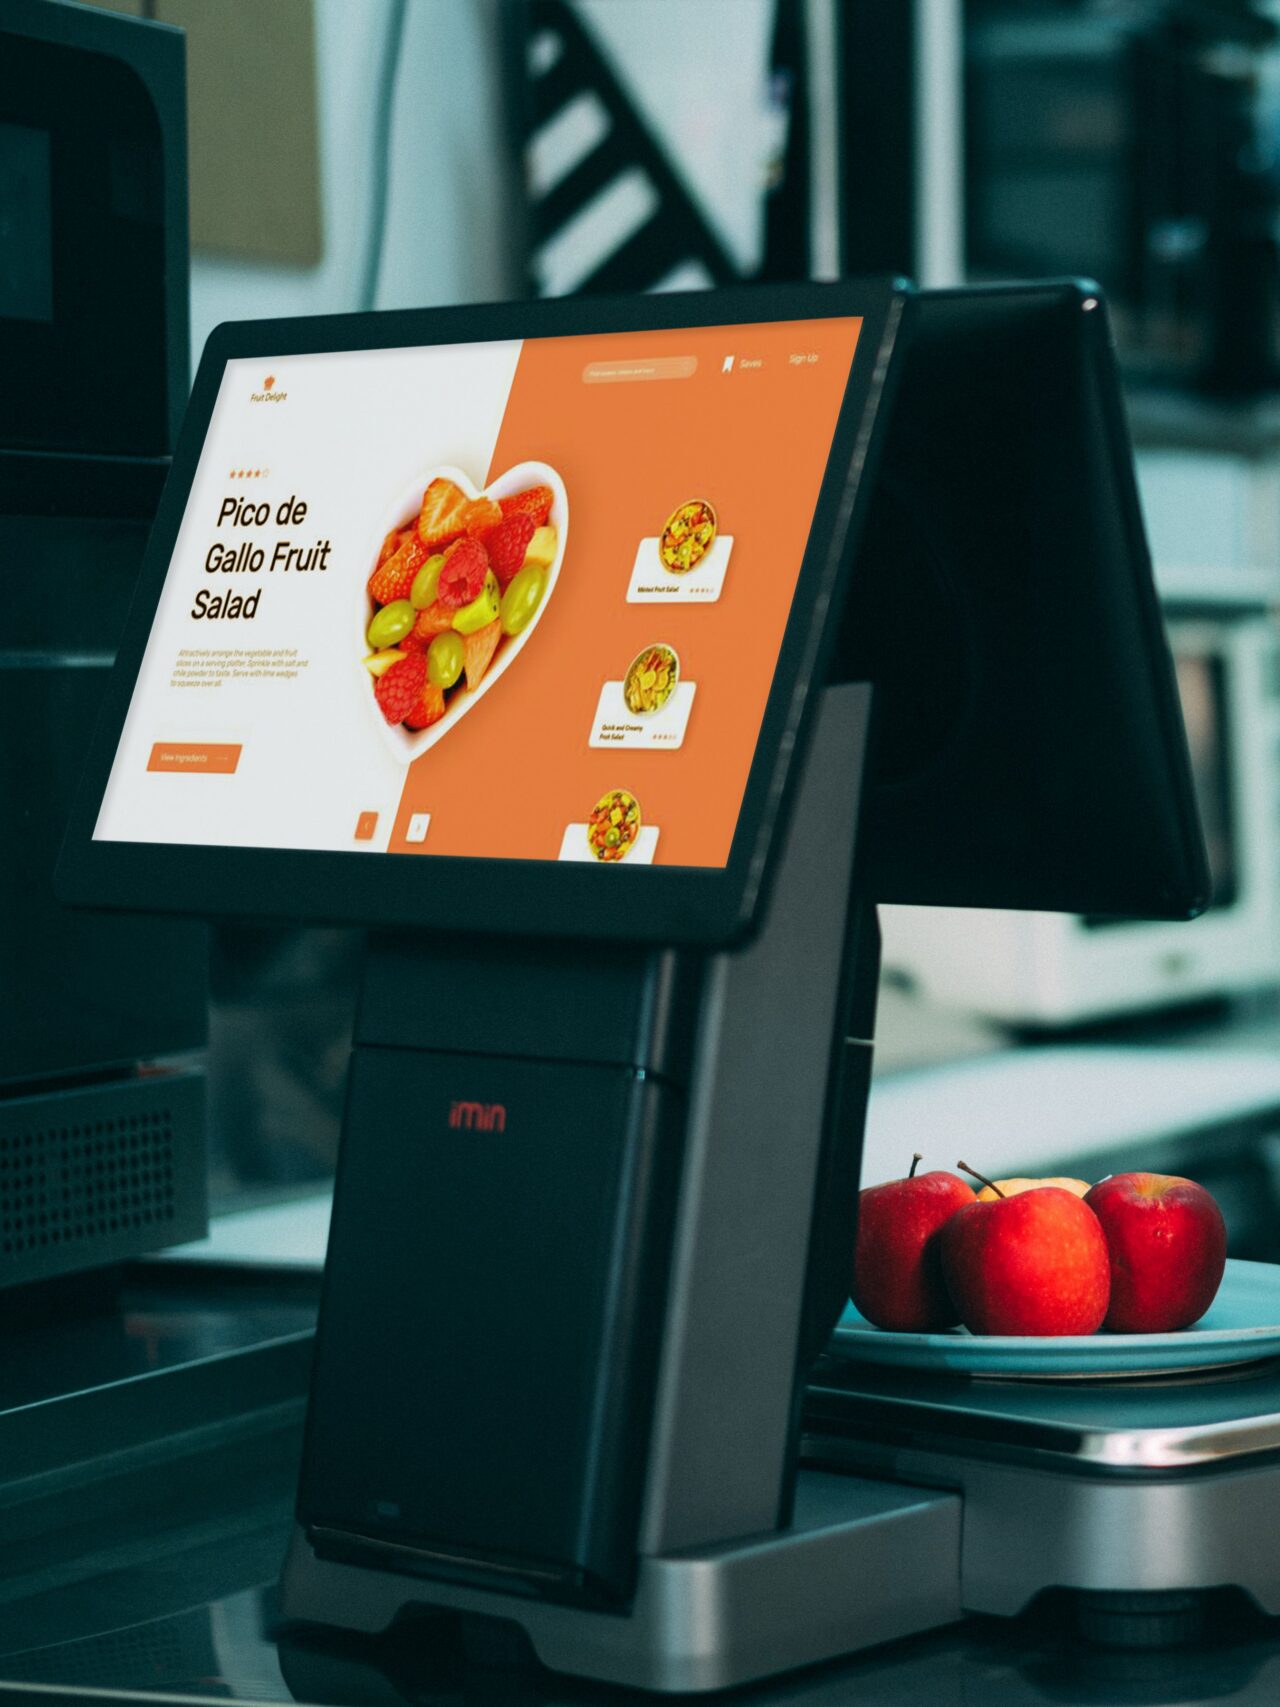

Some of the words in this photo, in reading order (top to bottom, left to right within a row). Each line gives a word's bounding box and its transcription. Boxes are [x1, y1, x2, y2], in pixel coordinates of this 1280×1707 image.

[250, 393, 265, 402] Fruit
[265, 392, 287, 404] Delight
[217, 496, 270, 527] Pico
[276, 495, 307, 525] de
[205, 542, 265, 573] Gallo
[270, 540, 331, 572] Fruit
[191, 588, 261, 619] Salad
